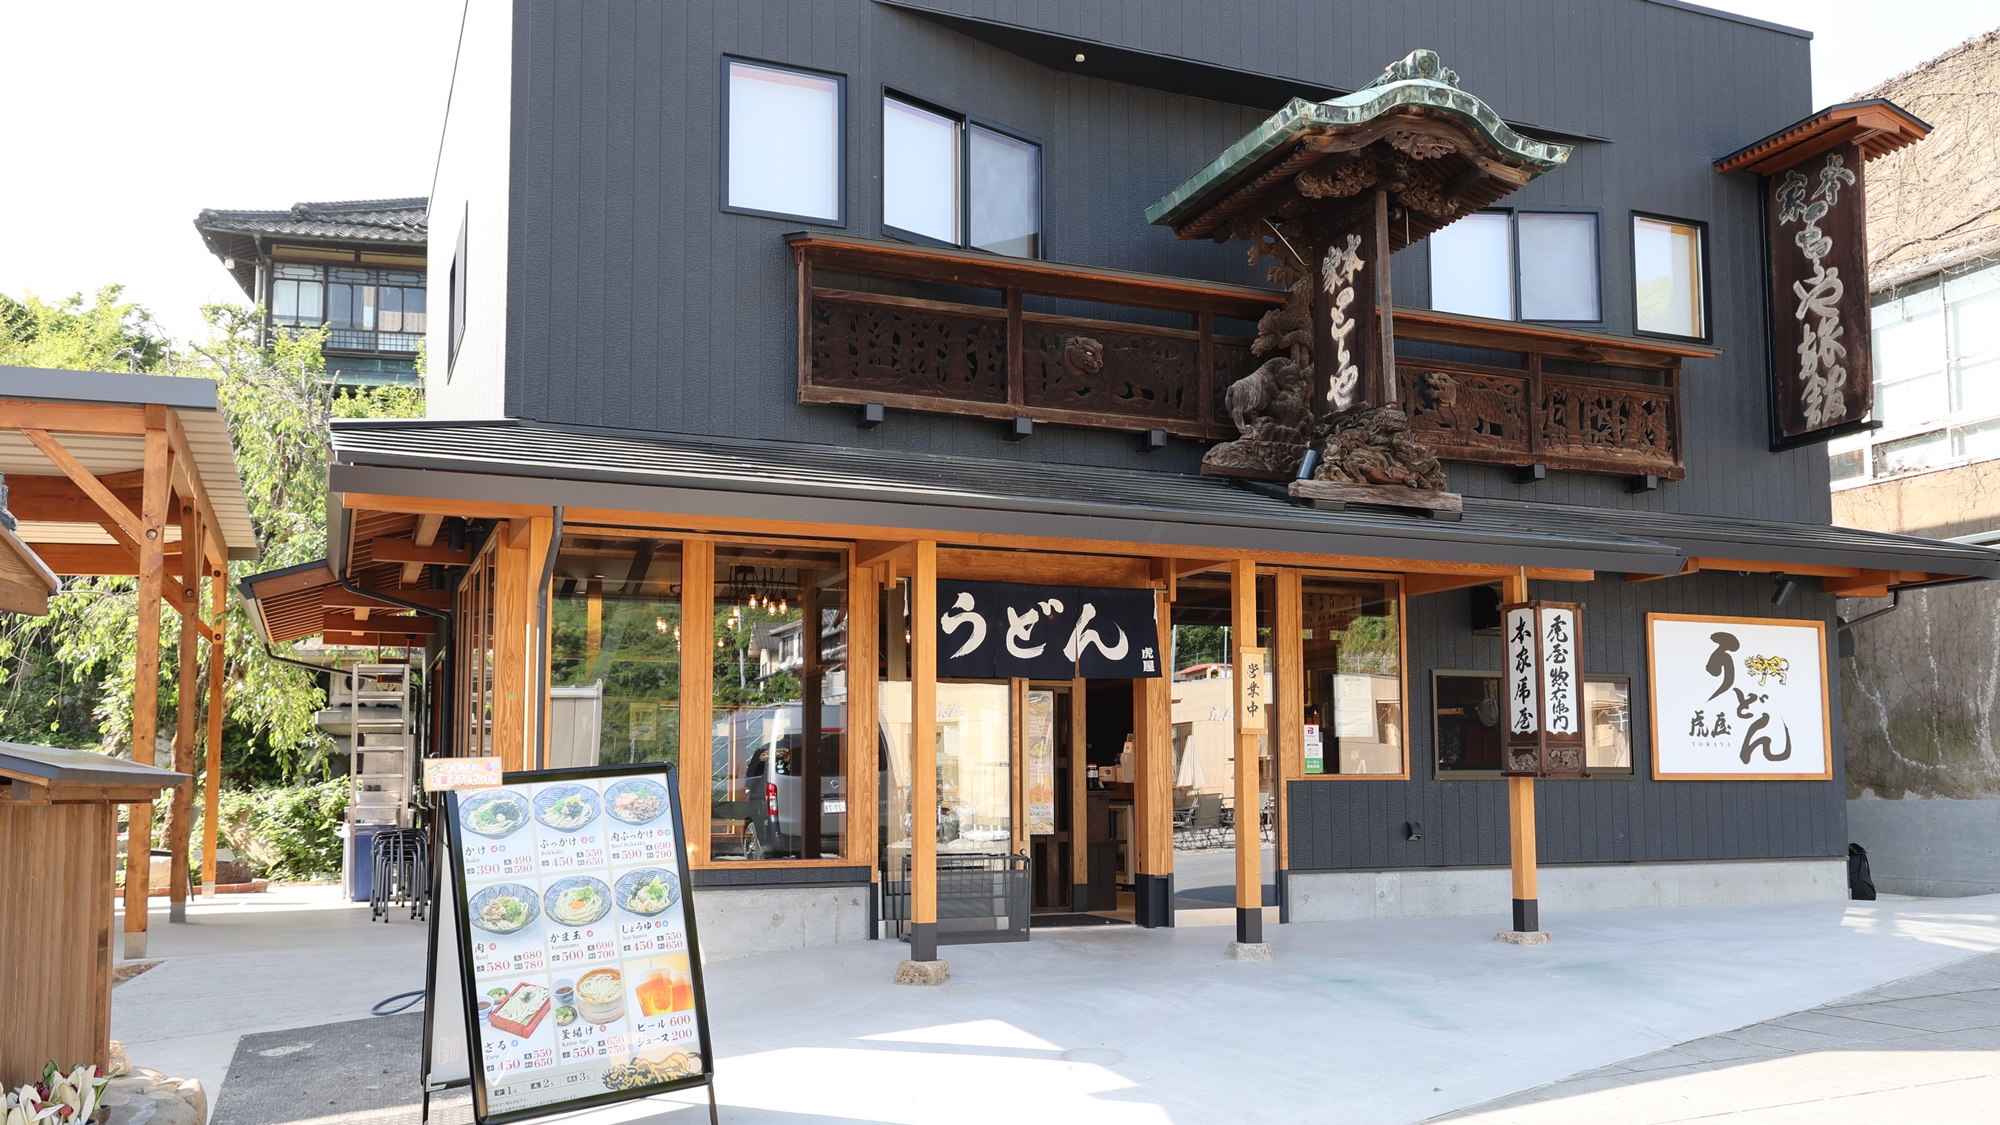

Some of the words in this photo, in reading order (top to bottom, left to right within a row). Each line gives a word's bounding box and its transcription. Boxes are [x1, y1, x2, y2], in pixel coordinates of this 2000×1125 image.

[940, 591, 1129, 662] うどん
[1141, 646, 1155, 672] 虎屋
[1246, 662, 1260, 718] 営業中
[1704, 631, 1792, 765] うどん
[1689, 709, 1732, 738] 虎屋
[445, 762, 483, 772] お子さまへ
[611, 829, 653, 842] 肉ぶっかけ
[540, 836, 577, 849] ぶっかけ
[654, 841, 671, 850] 690
[465, 845, 486, 856] かけ
[585, 848, 603, 857] 550
[621, 849, 642, 860] 590
[655, 849, 672, 859] 790
[513, 855, 532, 864] 490
[552, 856, 573, 867] 450
[586, 857, 604, 866] 650
[477, 863, 500, 875] 390
[514, 865, 533, 873] 590
[621, 922, 652, 934] しょうゆ
[549, 930, 582, 944] かま玉
[664, 931, 682, 941] 550
[474, 943, 485, 954] 肉
[551, 942, 580, 951] Kamatama
[595, 940, 614, 951] 600
[632, 939, 654, 952] 450
[665, 940, 683, 950] 650
[522, 950, 543, 961] 680
[561, 949, 584, 962] 500
[596, 949, 615, 960] 700
[486, 959, 511, 973] 580
[523, 959, 544, 970] 780
[637, 1019, 666, 1033] ビール
[669, 1014, 691, 1027] 600
[560, 1025, 595, 1041] 釜揚げ
[637, 1033, 670, 1047] ジュース
[671, 1028, 693, 1041] 200
[561, 1039, 590, 1048] Kama-Age
[606, 1035, 625, 1046] 650
[485, 1040, 507, 1054] ざる
[572, 1045, 595, 1059] 550
[607, 1044, 626, 1055] 750
[533, 1048, 553, 1058] 550
[497, 1058, 521, 1072] 450
[533, 1057, 553, 1068] 650
